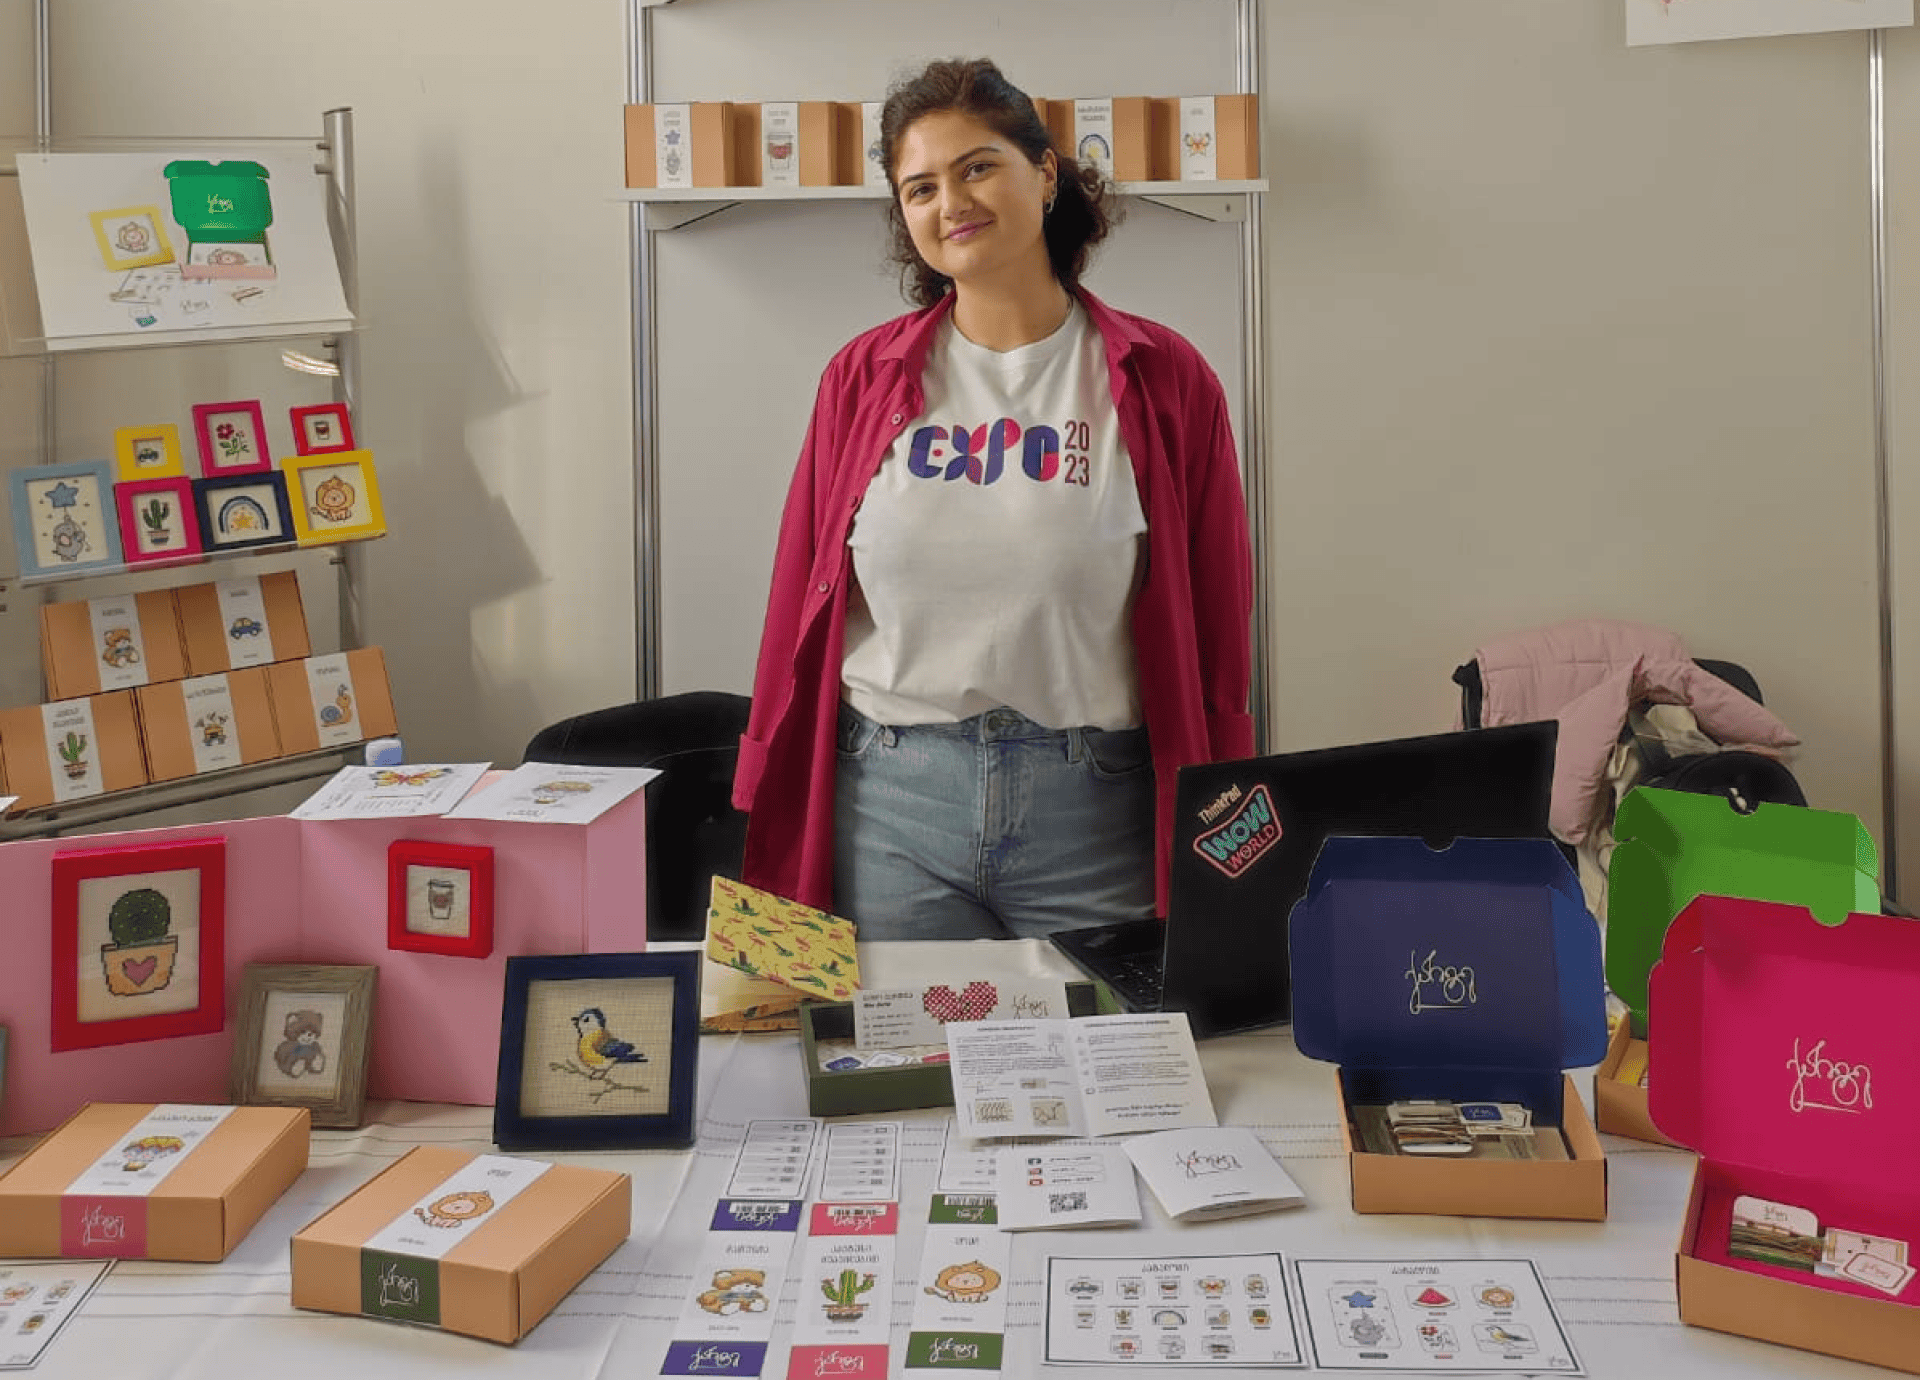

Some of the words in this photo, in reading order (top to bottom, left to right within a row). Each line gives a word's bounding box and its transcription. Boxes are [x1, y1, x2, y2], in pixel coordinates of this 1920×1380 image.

[907, 416, 1060, 486] EXPO
[1064, 420, 1090, 451] 20
[1064, 453, 1090, 488] 23
[1197, 783, 1242, 825] ThinkPad
[1200, 792, 1270, 861] WOW
[1226, 824, 1275, 870] WORLD
